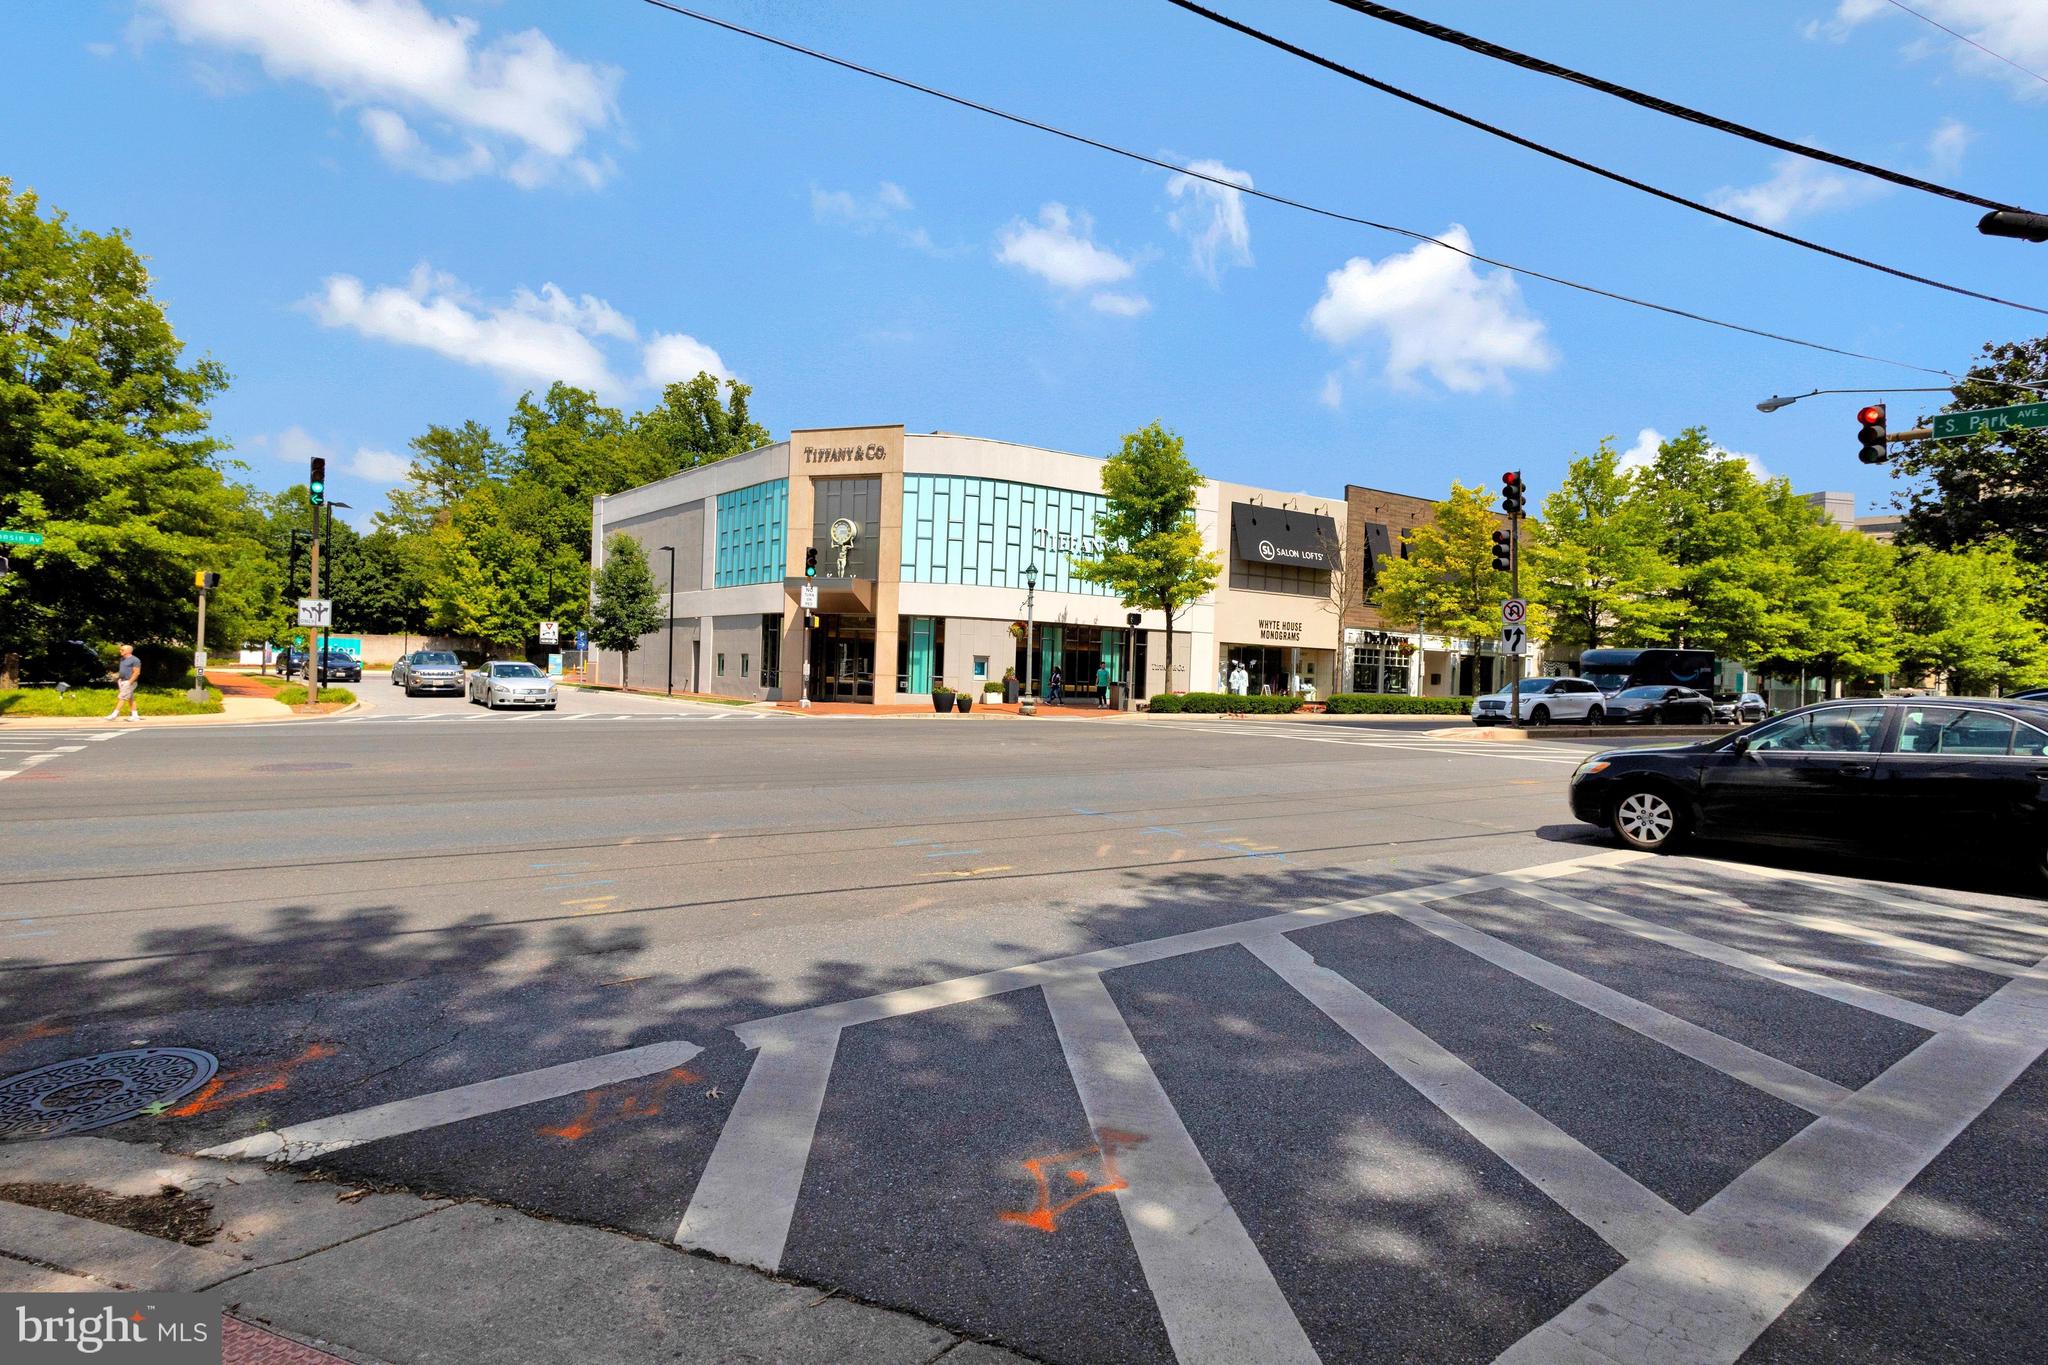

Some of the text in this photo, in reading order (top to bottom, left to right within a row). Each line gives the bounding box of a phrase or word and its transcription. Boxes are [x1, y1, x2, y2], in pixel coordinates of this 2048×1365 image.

[1969, 412, 2008, 430] Park
[804, 446, 854, 463] TIFFANY
[854, 444, 864, 461] &
[1261, 545, 1273, 555] SL
[1276, 547, 1300, 558] SALON
[1258, 619, 1303, 632] WHYTE HOUSE
[1260, 629, 1300, 641] MONOGRAMS
